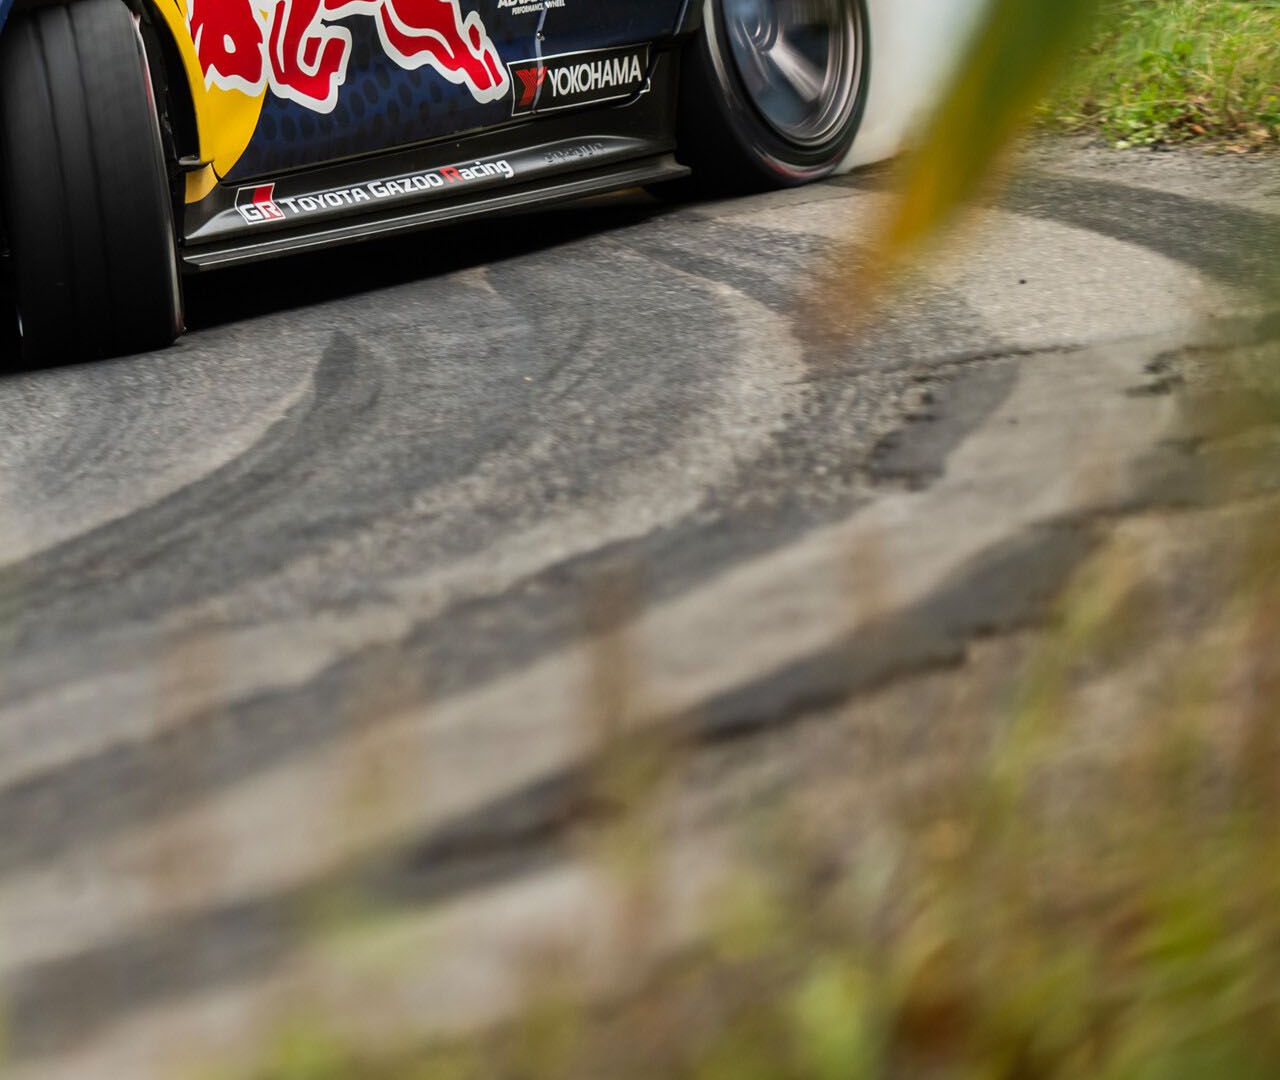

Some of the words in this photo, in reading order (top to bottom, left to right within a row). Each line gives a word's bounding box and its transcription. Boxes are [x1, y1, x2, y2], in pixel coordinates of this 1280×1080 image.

[547, 55, 642, 97] YOKOHAMA
[241, 200, 283, 222] GR
[279, 186, 364, 215] TOYOTA
[365, 172, 444, 200] GAZOO
[442, 160, 514, 184] Racing
